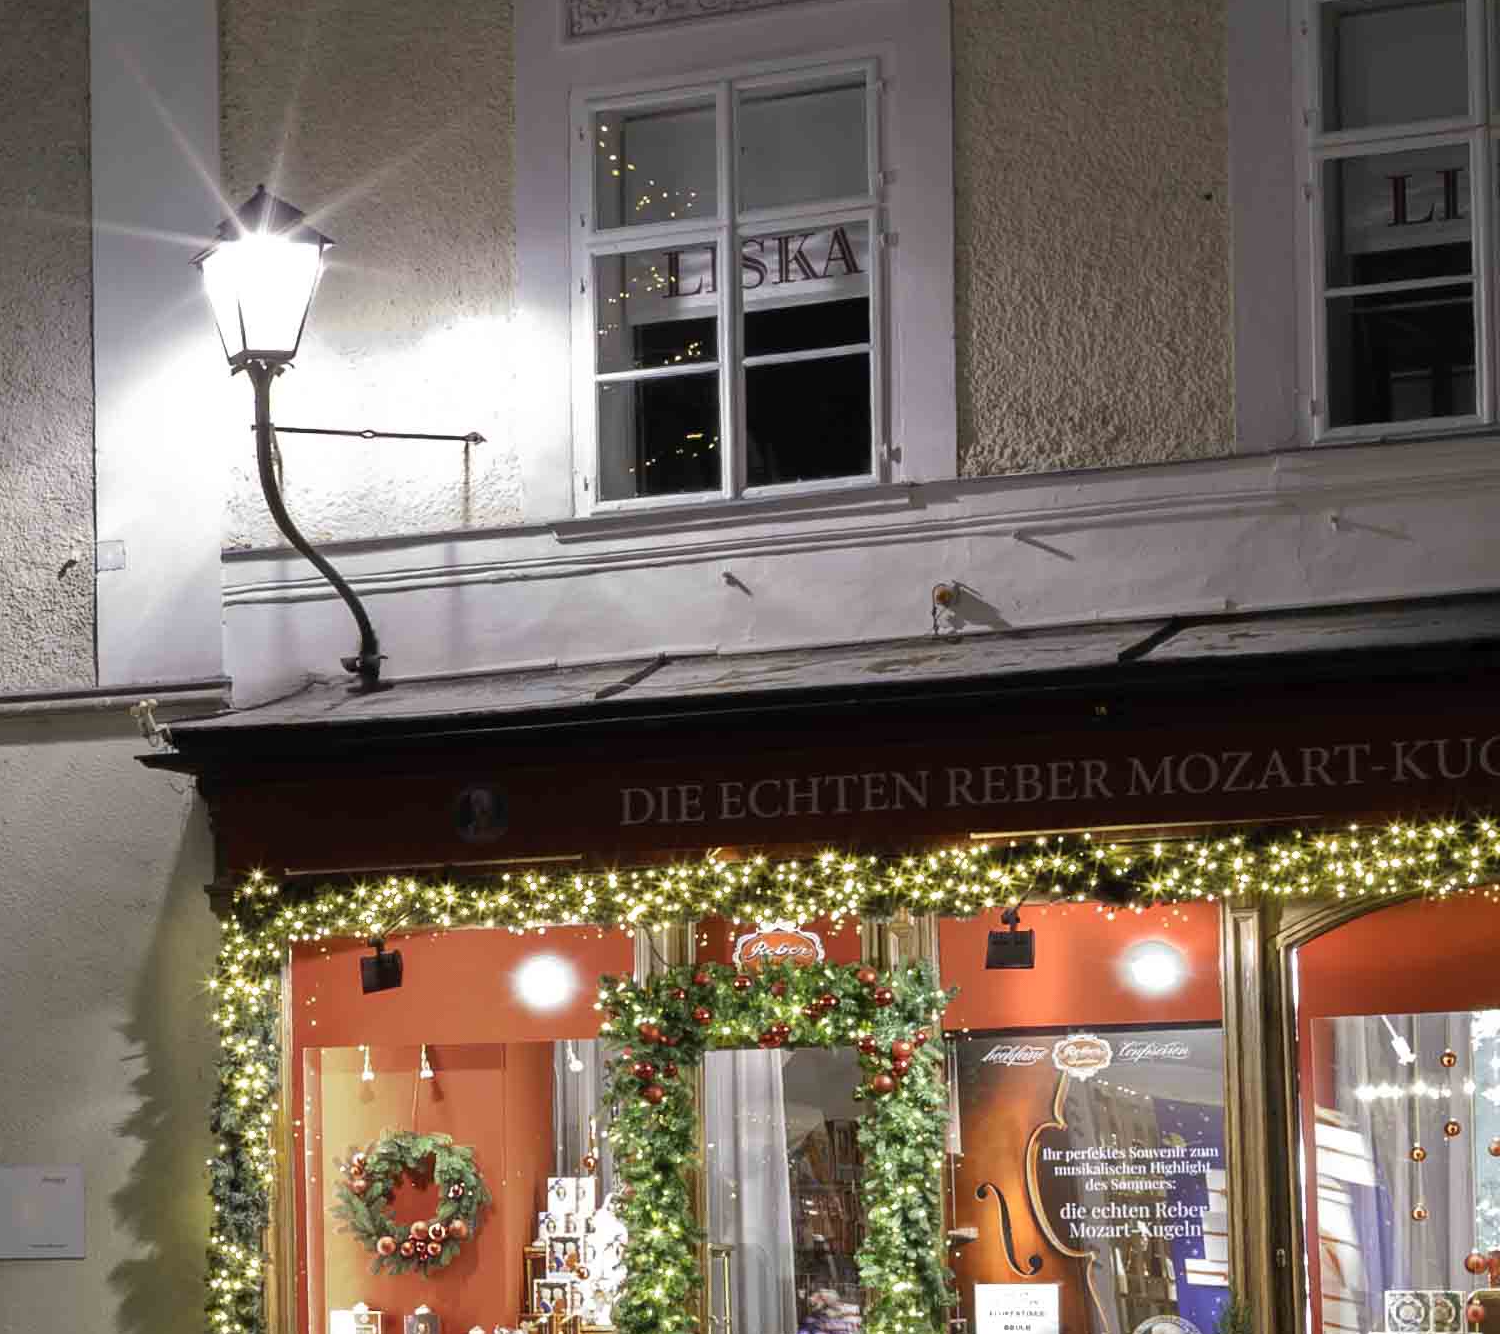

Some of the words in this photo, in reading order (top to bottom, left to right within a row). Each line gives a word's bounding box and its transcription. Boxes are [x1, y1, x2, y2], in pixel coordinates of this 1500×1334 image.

[1385, 167, 1465, 228] LI
[661, 225, 866, 299] LISKA
[619, 784, 707, 826] DIE
[716, 770, 930, 820] ECHTEN
[944, 759, 1115, 807] REBER
[1042, 1148, 1063, 1161] Ihr
[1066, 1147, 1126, 1163] perfektes
[1128, 1146, 1187, 1159] Souvenir
[1189, 1147, 1219, 1158] zum
[1054, 1162, 1147, 1176] musikalischen
[1150, 1161, 1212, 1176] Highlight
[1085, 1178, 1108, 1191] des
[1111, 1178, 1177, 1191] Sommers:
[1060, 1202, 1087, 1220] die
[1091, 1202, 1150, 1220] echten
[1155, 1201, 1208, 1219] Reber
[1069, 1220, 1201, 1240] Mozart-Kugeln
